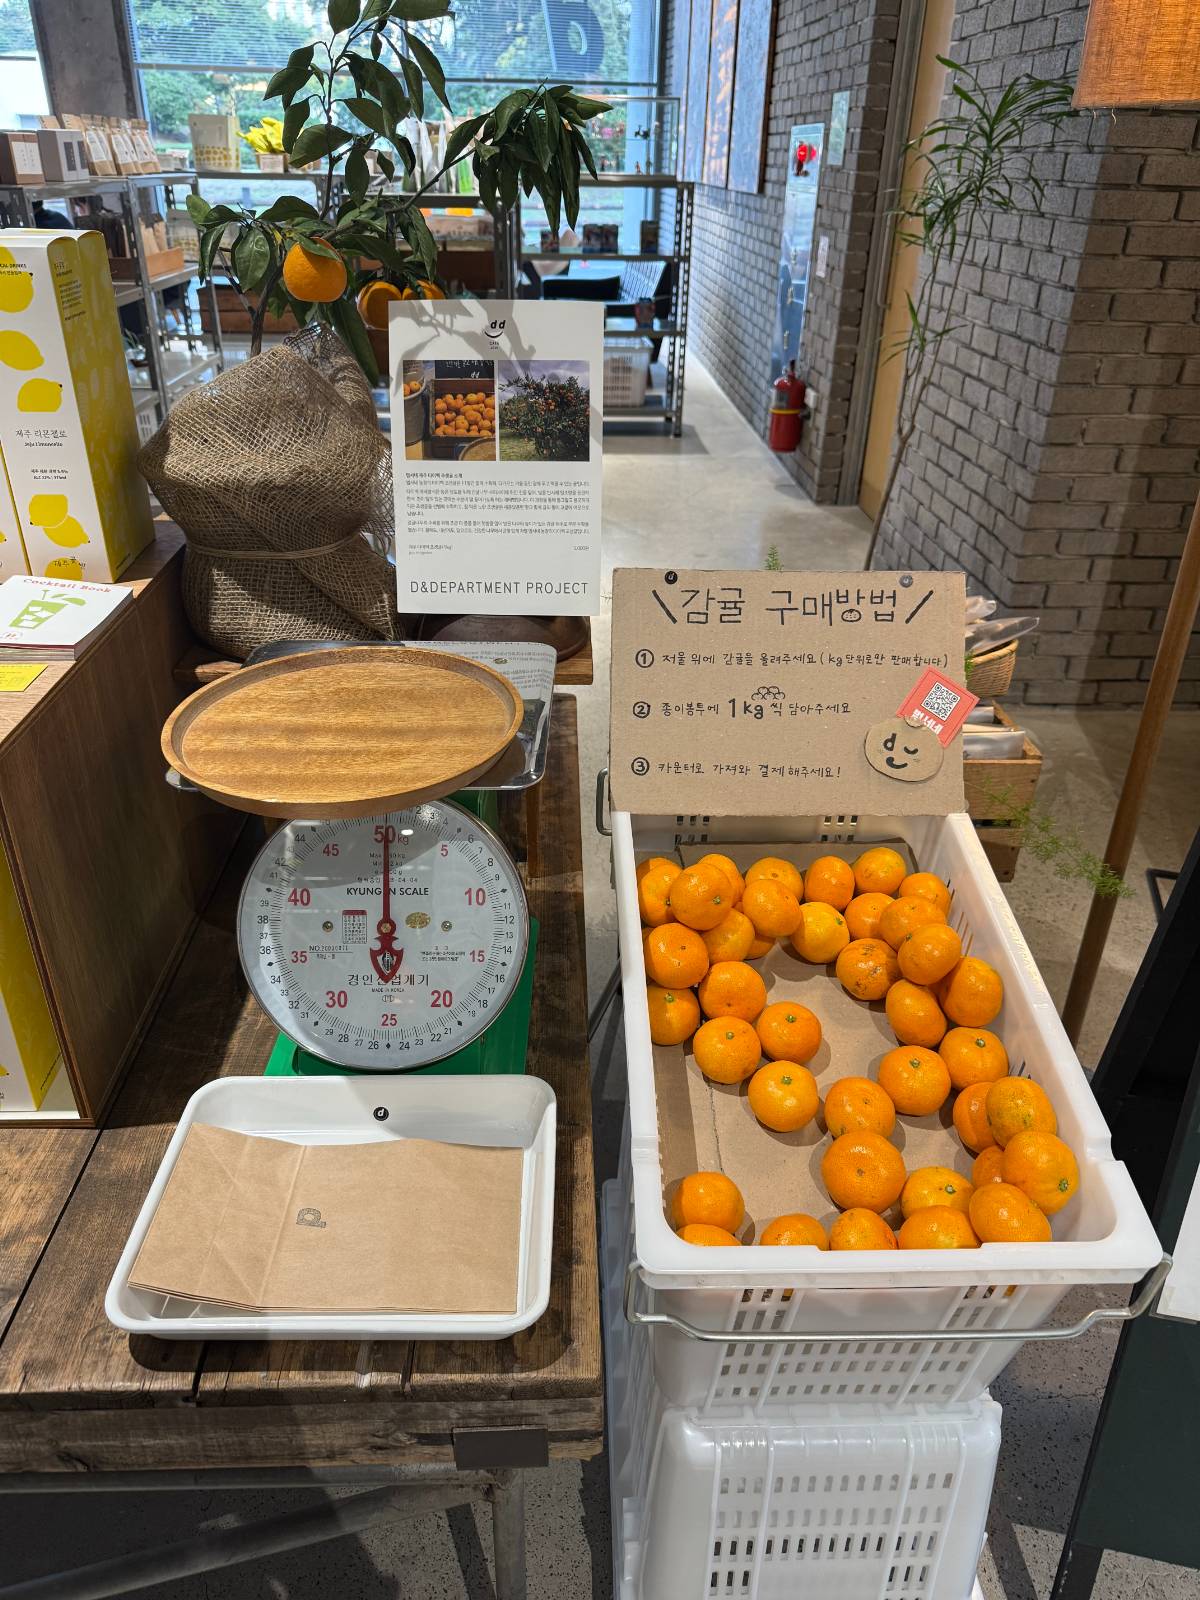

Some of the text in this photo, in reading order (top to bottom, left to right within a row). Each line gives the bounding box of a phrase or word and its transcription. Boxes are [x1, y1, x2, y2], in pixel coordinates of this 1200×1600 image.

[23, 578, 112, 593] Cocktail Book
[410, 581, 589, 595] D&DEPARTMENT PROJECT
[681, 587, 897, 626] 감귤 구매방법
[662, 651, 686, 665] 저울
[691, 653, 715, 665] 위에
[661, 702, 719, 717] 종이봉투에
[770, 702, 783, 717] 씩
[788, 702, 852, 716] 담아주세요
[658, 762, 704, 775] 카운터로
[713, 763, 751, 776] 가져와
[416, 805, 422, 815] 2
[443, 817, 449, 826] 4
[294, 833, 306, 842] 44
[373, 825, 397, 844] 50
[467, 833, 474, 844] 6
[323, 843, 340, 857] 45
[440, 844, 449, 857] 5
[487, 857, 494, 867] 8
[269, 871, 278, 880] 41
[494, 873, 500, 881] 9
[288, 887, 311, 906] 40
[346, 887, 382, 896] KYUNG
[399, 887, 429, 896] SCALE
[465, 887, 487, 906] 10
[259, 899, 269, 907] 39
[504, 902, 512, 910] 11
[257, 914, 269, 924] 38
[504, 915, 515, 925] 12
[259, 932, 268, 940] 37
[505, 931, 514, 939] 13
[260, 945, 272, 955] 36
[502, 945, 513, 955] 14
[291, 950, 308, 964] 35
[469, 950, 486, 963] 15
[270, 975, 281, 985] 34
[494, 974, 506, 983] 16
[280, 989, 289, 997] 33
[487, 986, 496, 994] 17
[325, 990, 348, 1009] 30
[430, 990, 453, 1008] 20
[477, 999, 488, 1009] 18
[288, 1000, 300, 1010] 32
[300, 1011, 309, 1019] 31
[468, 1010, 476, 1018] 19
[381, 1013, 398, 1027] 25
[325, 1028, 334, 1036] 29
[444, 1027, 452, 1035] 21
[338, 1033, 350, 1043] 28
[354, 1039, 364, 1047] 27
[430, 1033, 442, 1043] 22
[368, 1040, 379, 1050] 26
[399, 1041, 411, 1051] 24
